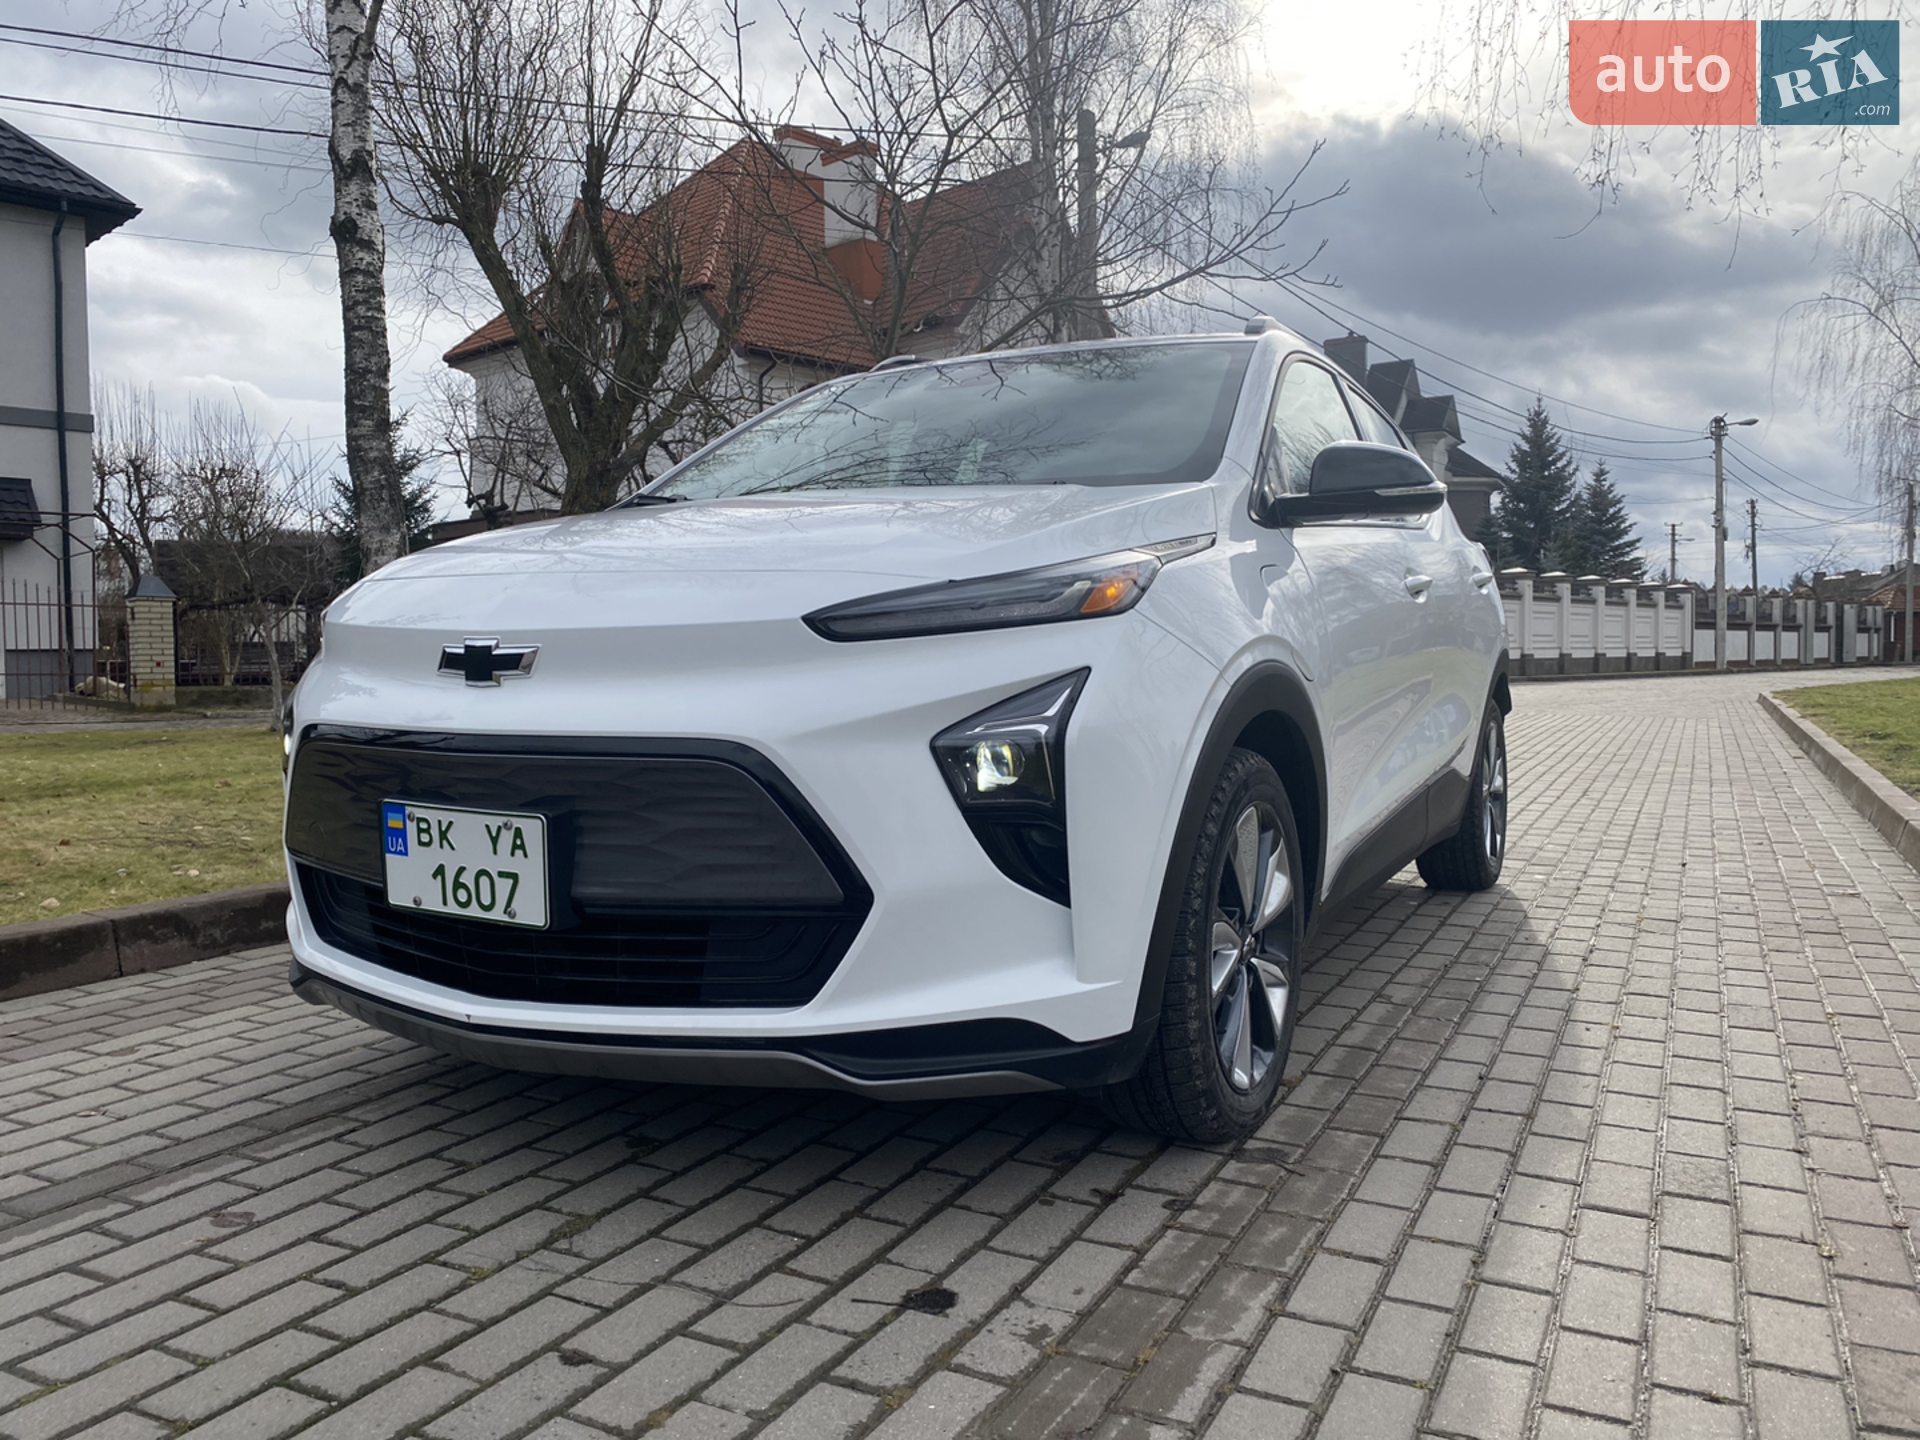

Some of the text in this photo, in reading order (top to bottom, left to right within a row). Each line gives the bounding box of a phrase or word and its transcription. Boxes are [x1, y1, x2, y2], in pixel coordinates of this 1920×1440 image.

[388, 836, 405, 853] UA
[416, 816, 528, 859] BK YA
[431, 863, 519, 915] 1607
